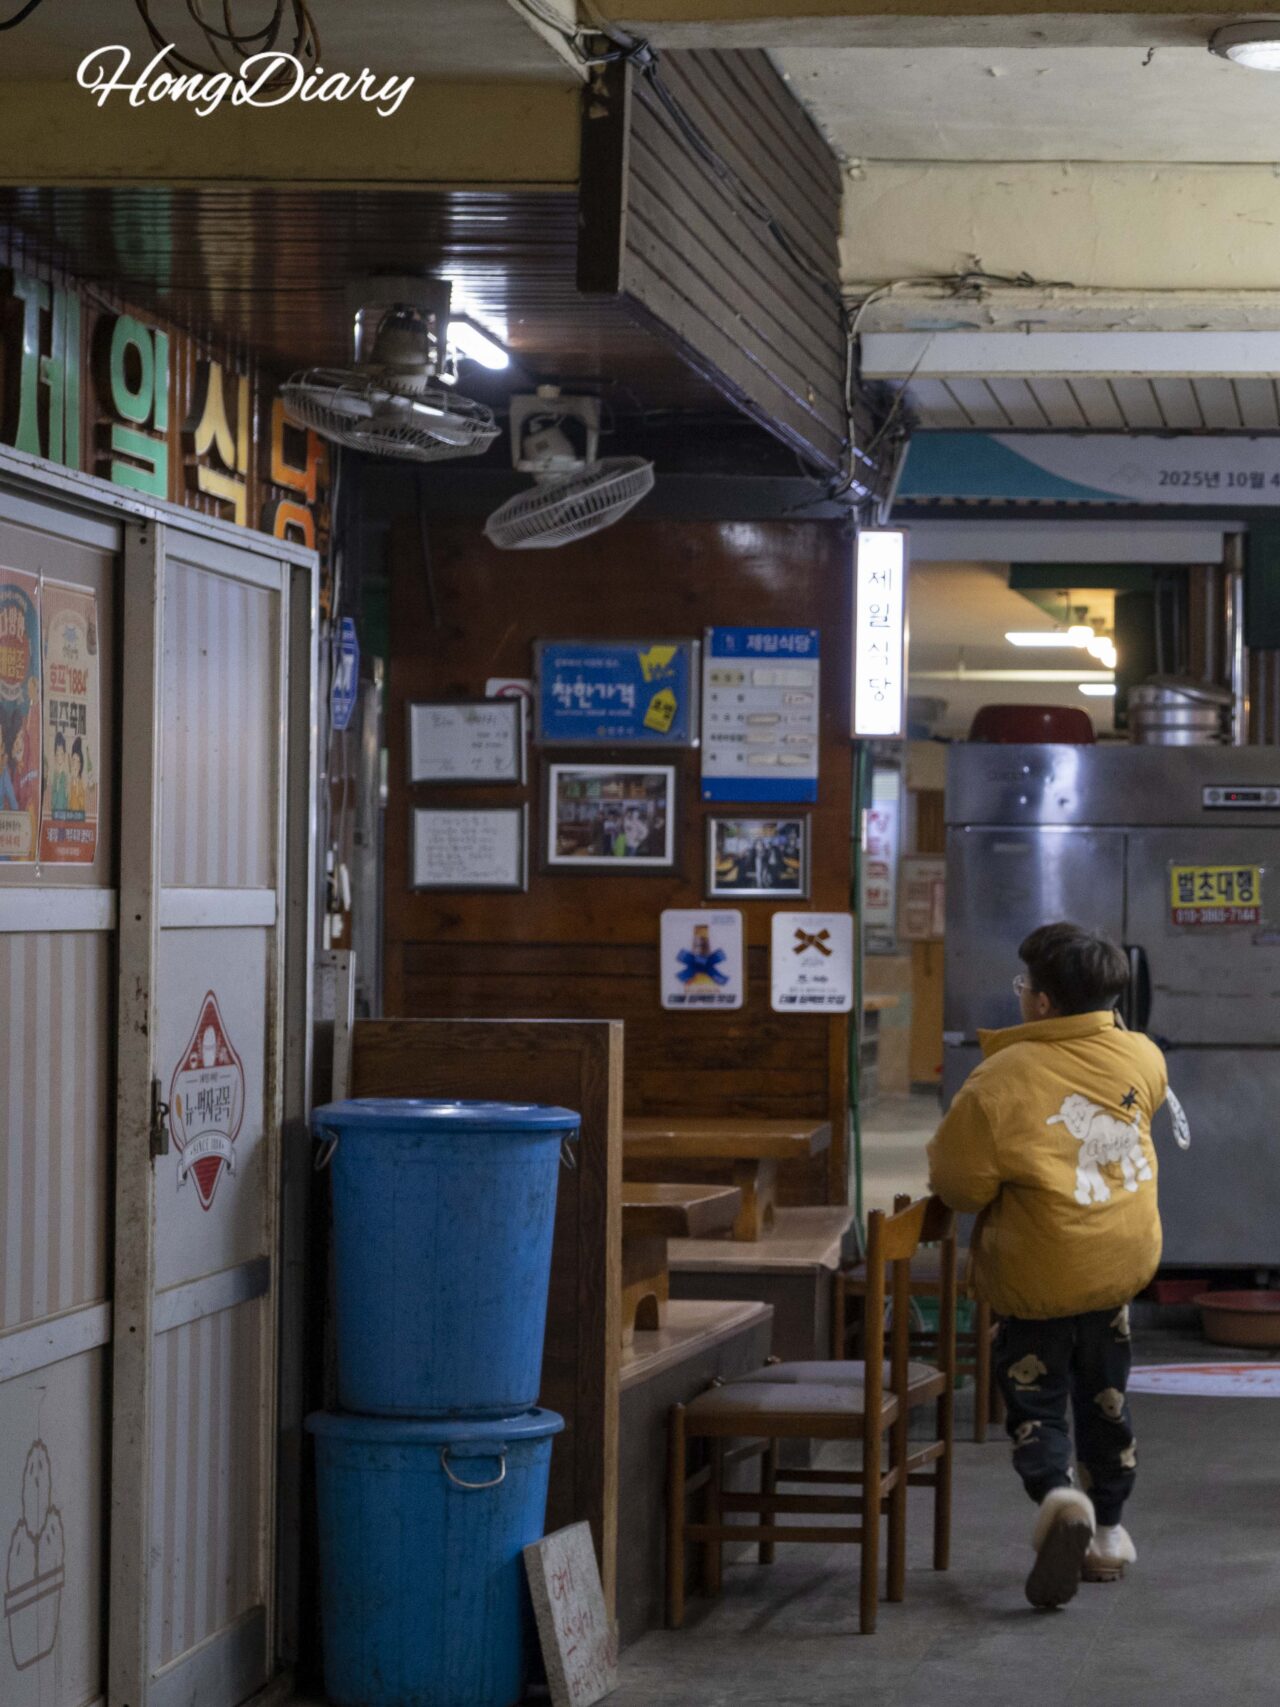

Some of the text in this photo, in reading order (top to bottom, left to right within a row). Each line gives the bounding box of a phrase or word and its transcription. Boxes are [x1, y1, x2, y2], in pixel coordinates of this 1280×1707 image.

[1158, 471, 1220, 489] 2025년
[1227, 471, 1265, 490] 10월
[868, 567, 893, 702] 제일식당
